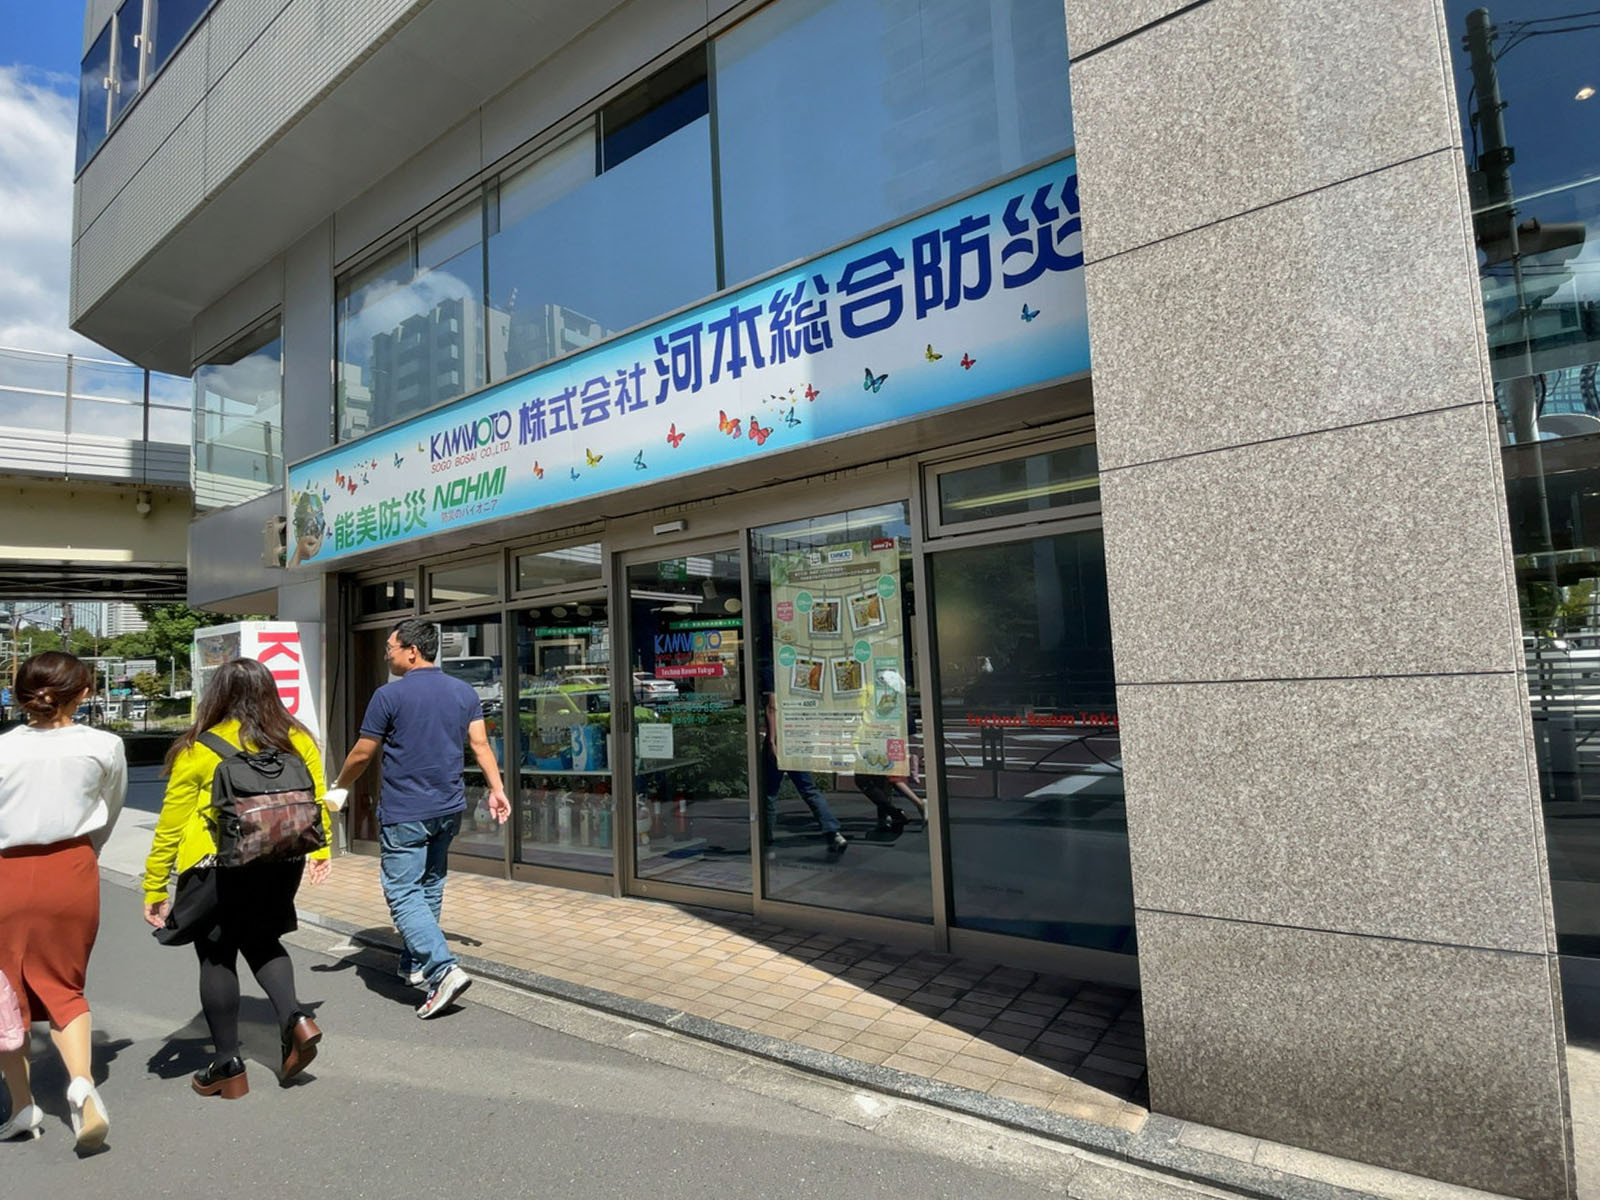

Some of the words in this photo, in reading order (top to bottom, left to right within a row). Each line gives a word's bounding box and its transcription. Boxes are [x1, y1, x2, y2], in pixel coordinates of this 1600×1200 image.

[431, 460, 452, 474] SOGO
[455, 451, 477, 467] BOSAI
[334, 487, 428, 551] 能美防災
[432, 466, 507, 512] NOHMI
[697, 667, 715, 675] Tokyo
[967, 712, 1022, 727] Techno
[1026, 711, 1075, 727] Room
